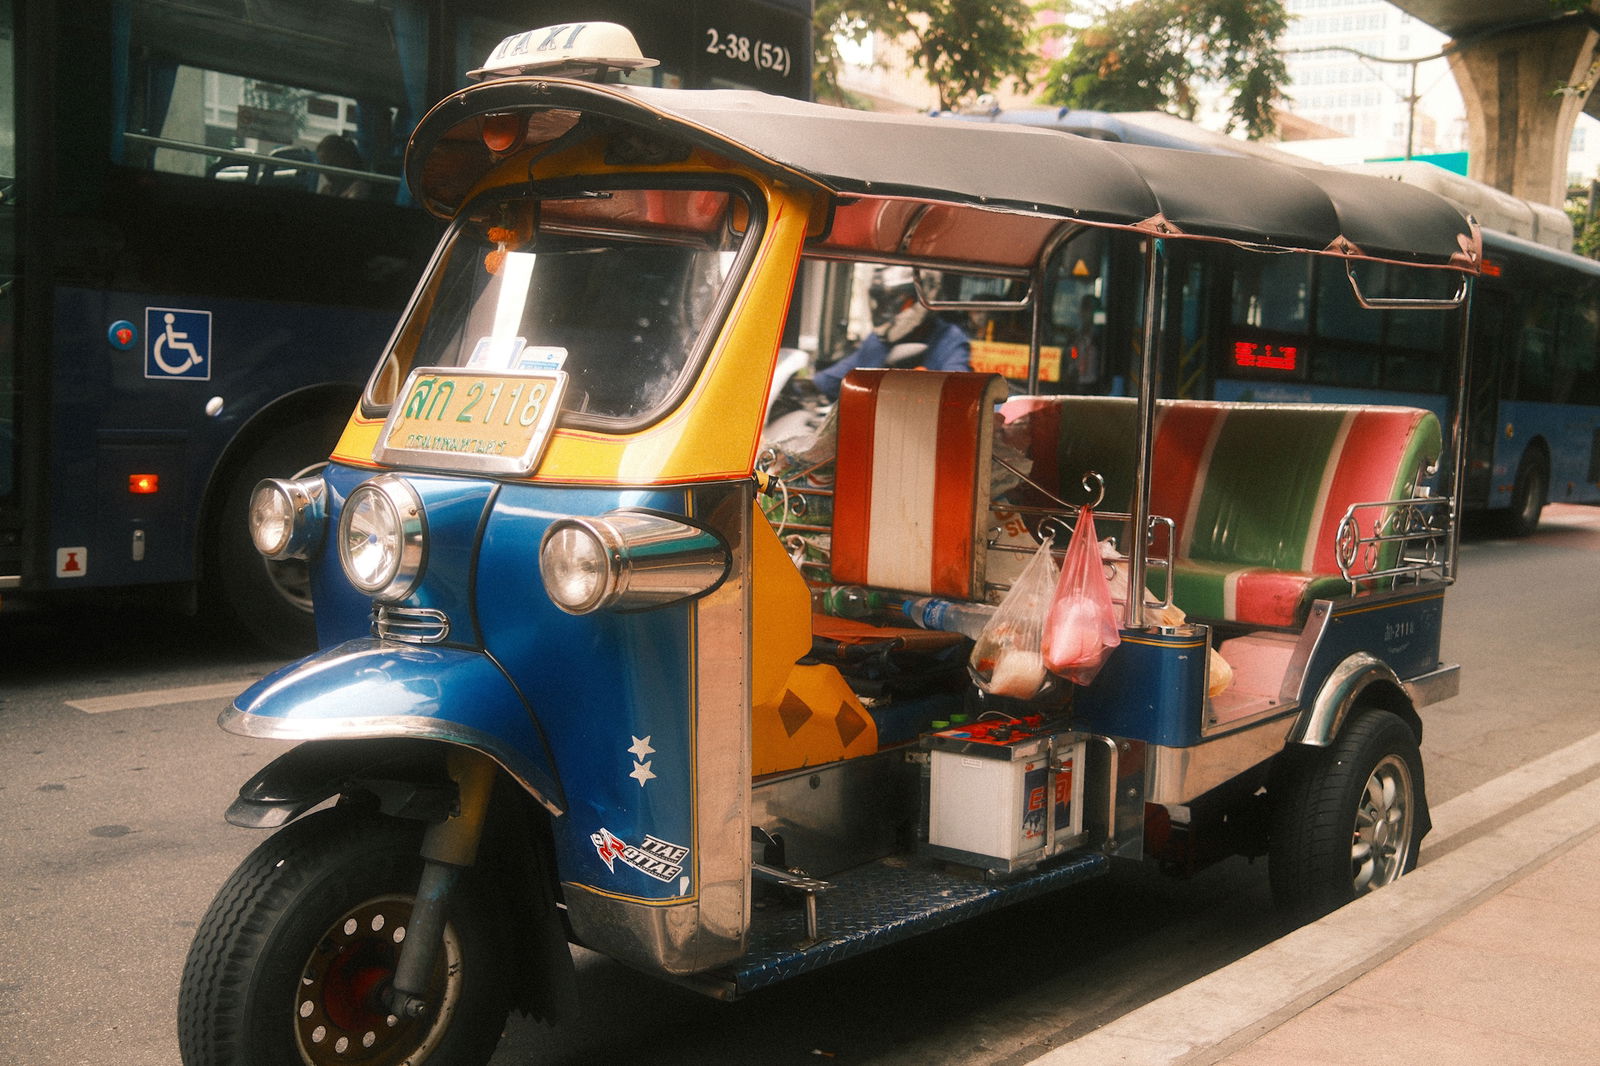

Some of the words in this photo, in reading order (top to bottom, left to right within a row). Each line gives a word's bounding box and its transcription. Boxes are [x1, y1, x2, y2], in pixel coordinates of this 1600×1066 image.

[497, 25, 586, 60] TAXI
[706, 28, 750, 62] 2-38
[754, 40, 791, 77] (52)
[405, 377, 456, 420] สก
[456, 380, 547, 426] 2118
